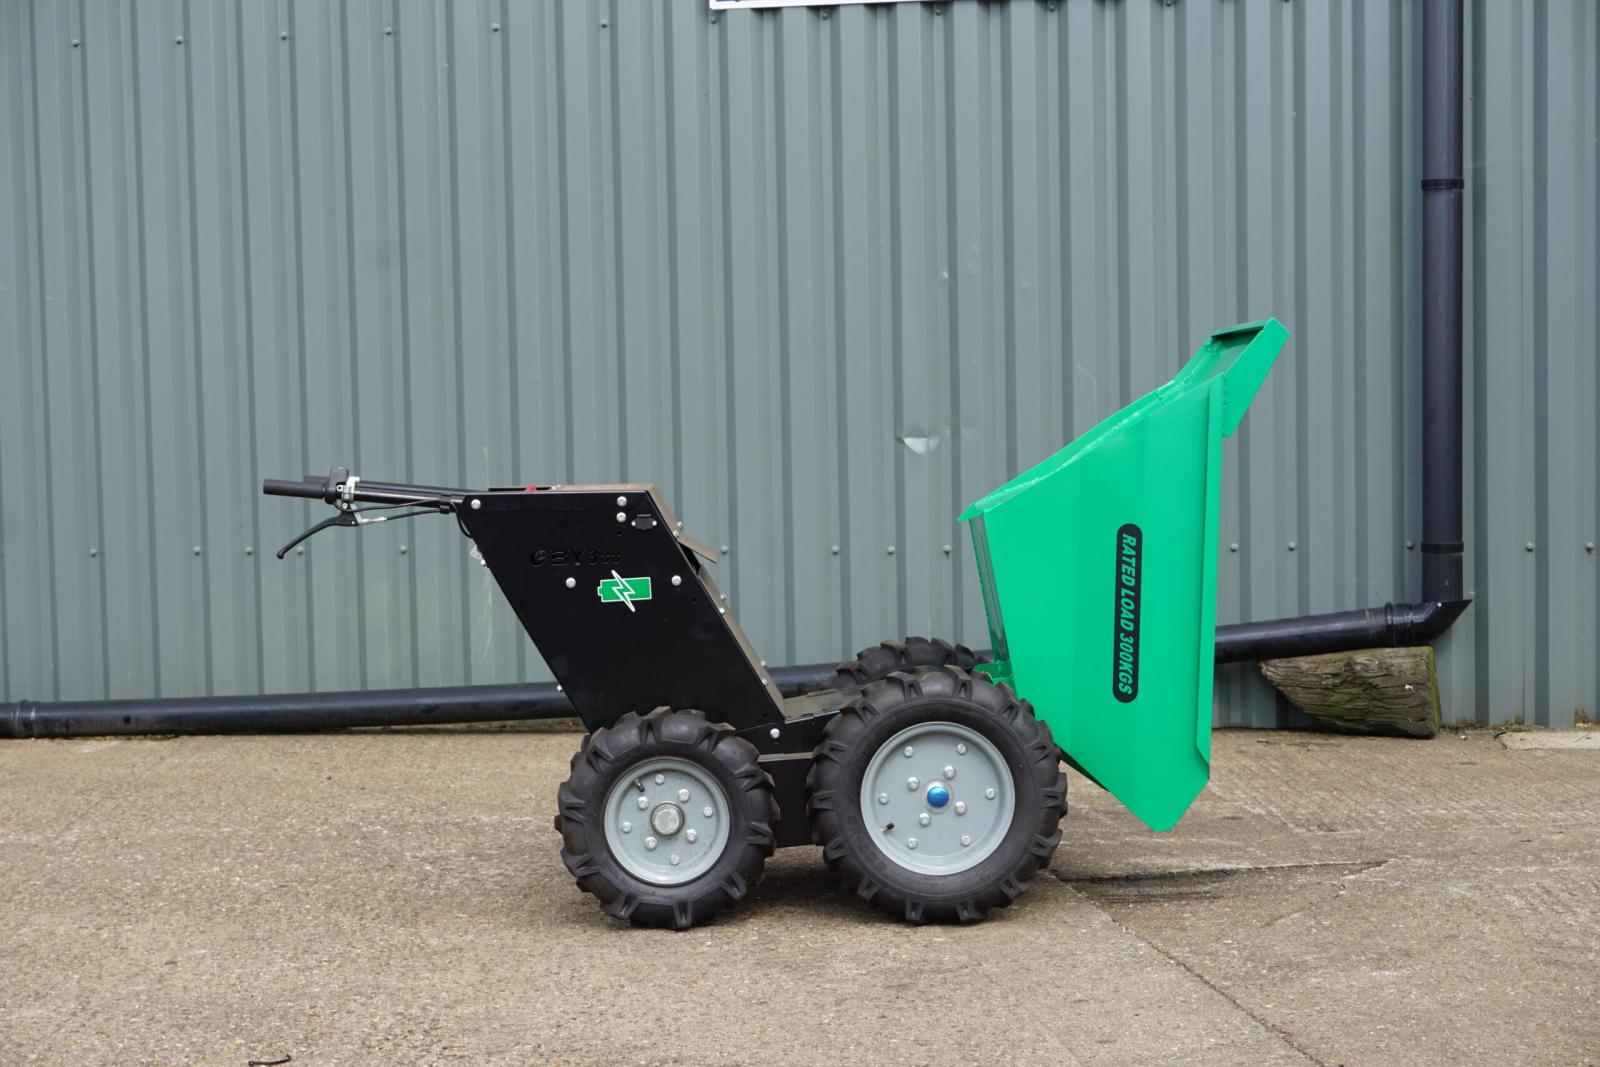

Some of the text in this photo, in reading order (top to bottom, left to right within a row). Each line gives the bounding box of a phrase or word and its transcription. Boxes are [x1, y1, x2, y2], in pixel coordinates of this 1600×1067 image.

[1118, 533, 1137, 694] RATED LOAD 300KGS
